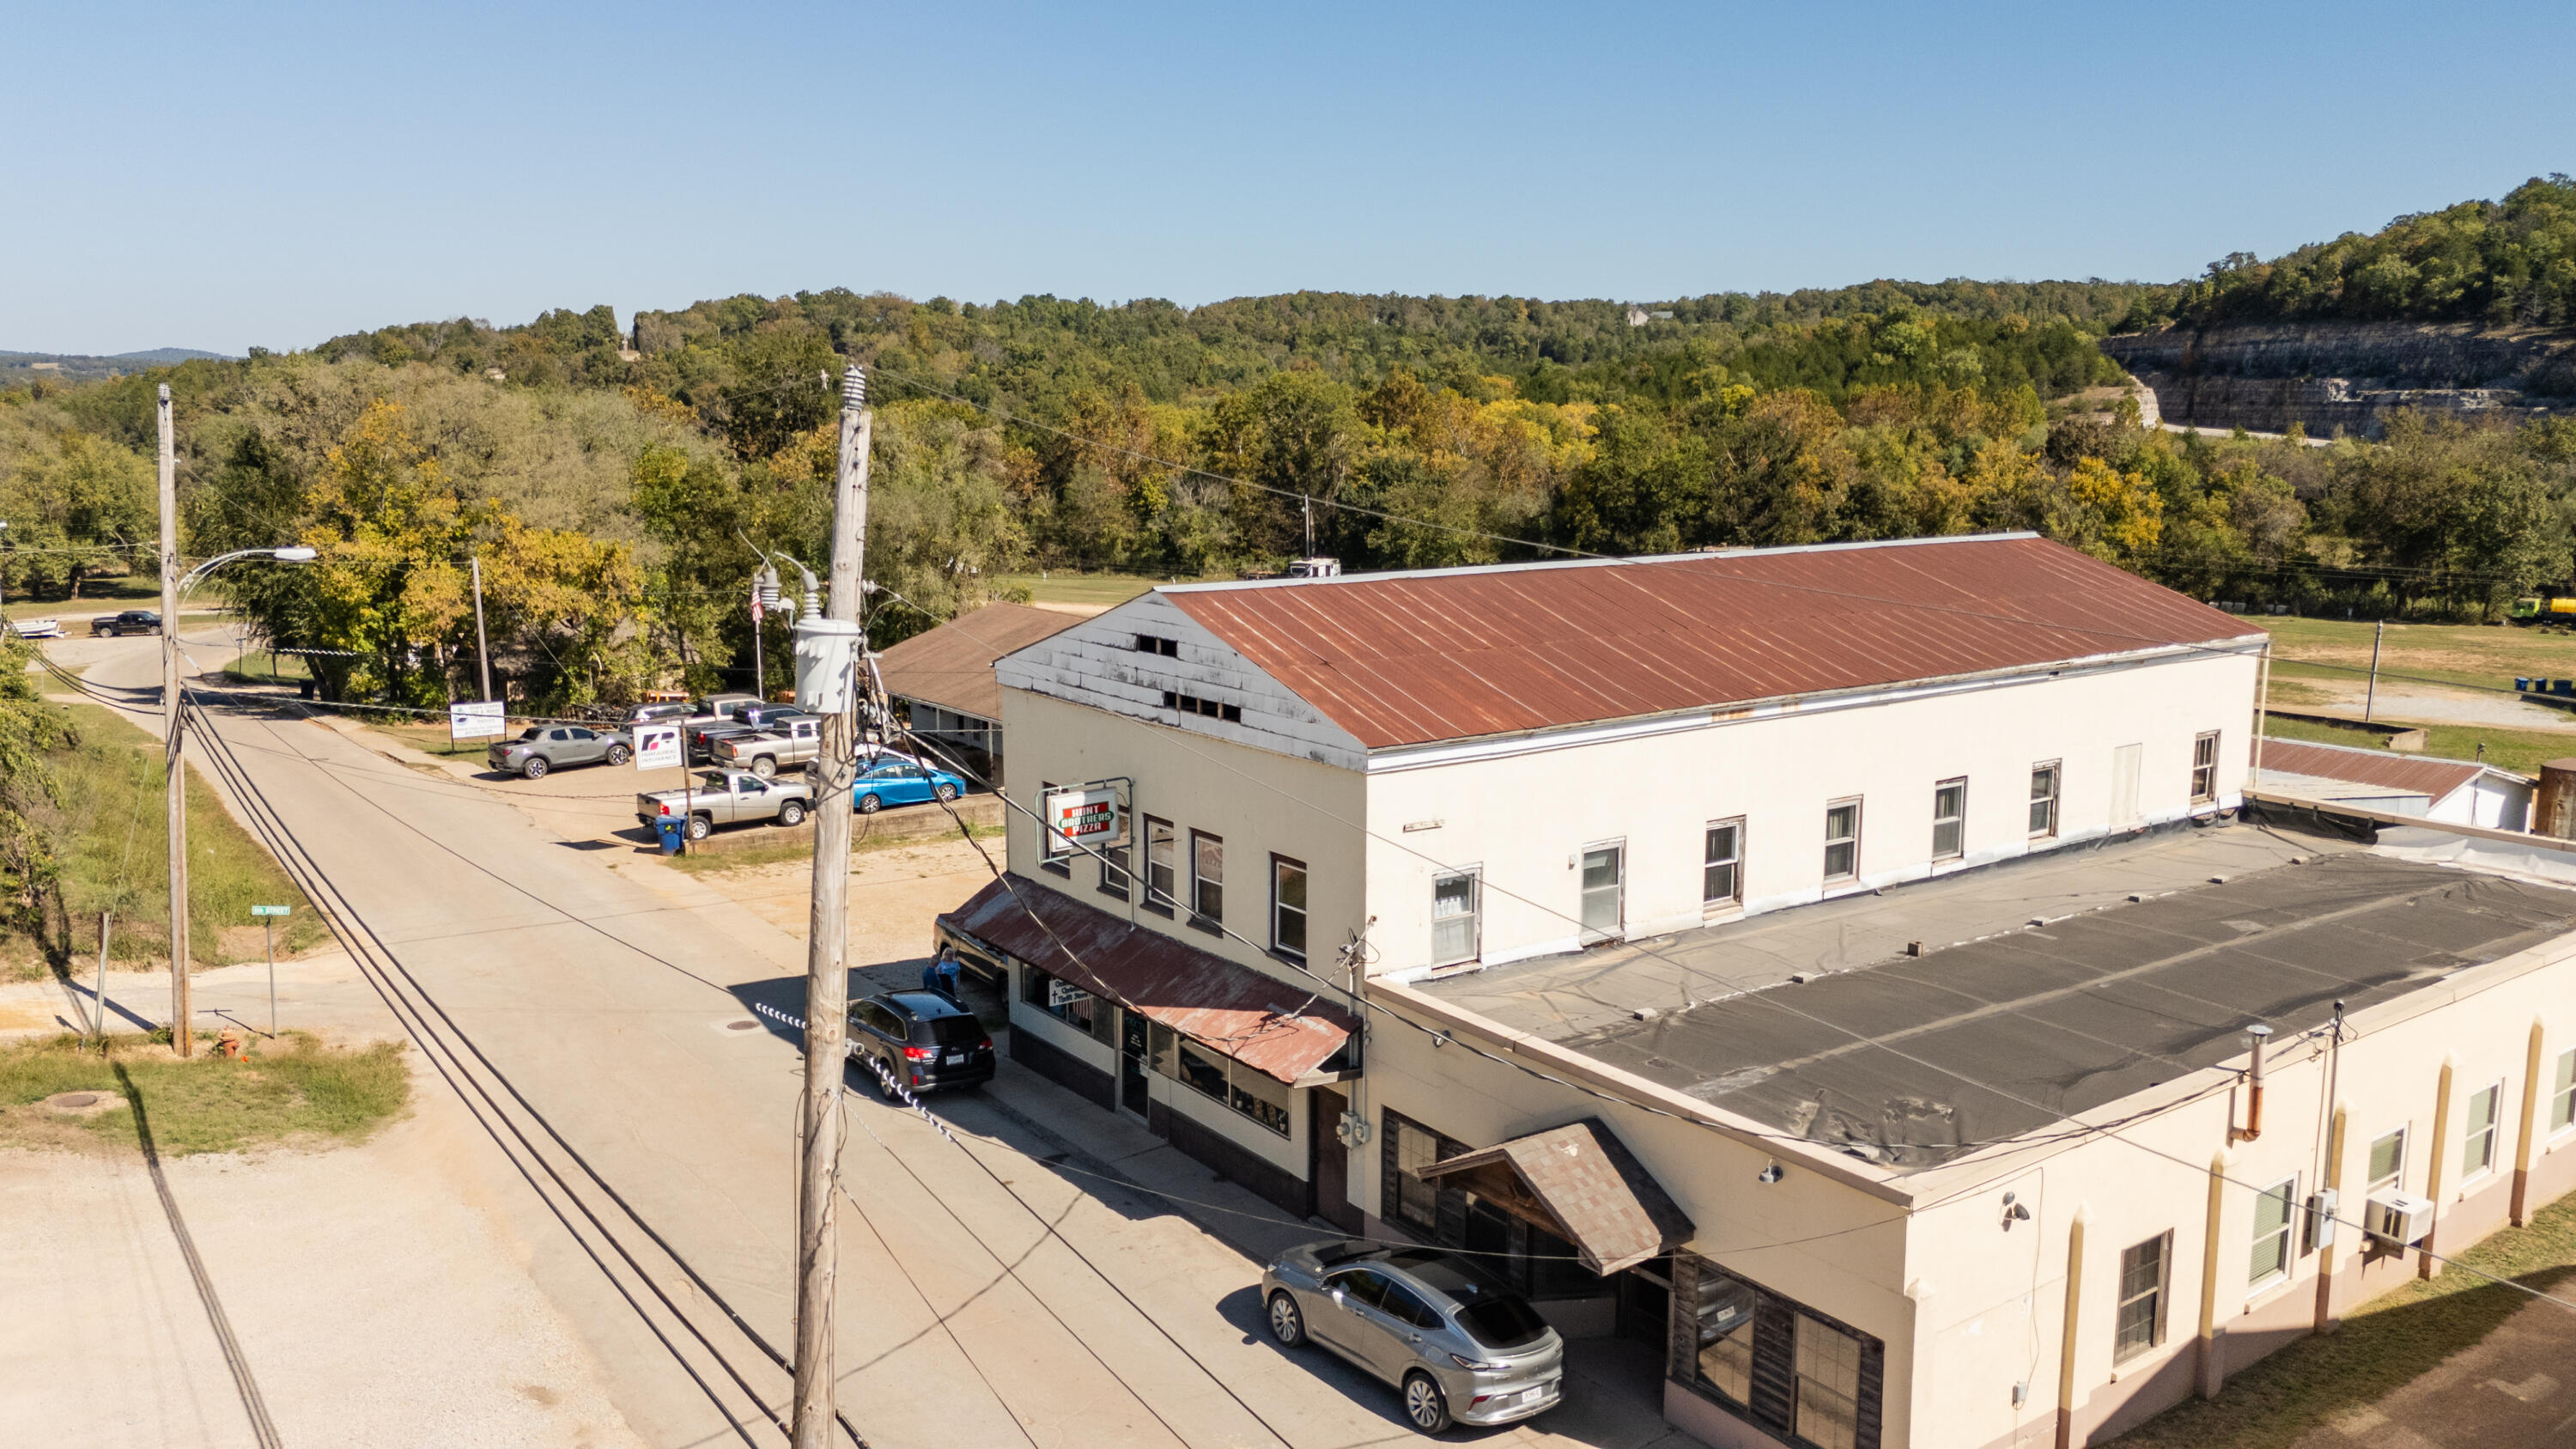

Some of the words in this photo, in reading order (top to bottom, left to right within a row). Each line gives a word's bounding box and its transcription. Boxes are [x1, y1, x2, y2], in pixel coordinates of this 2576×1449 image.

[1072, 805, 1099, 818] HUNT
[1060, 812, 1111, 828] BROTHERS
[1072, 822, 1102, 835] PIZZA
